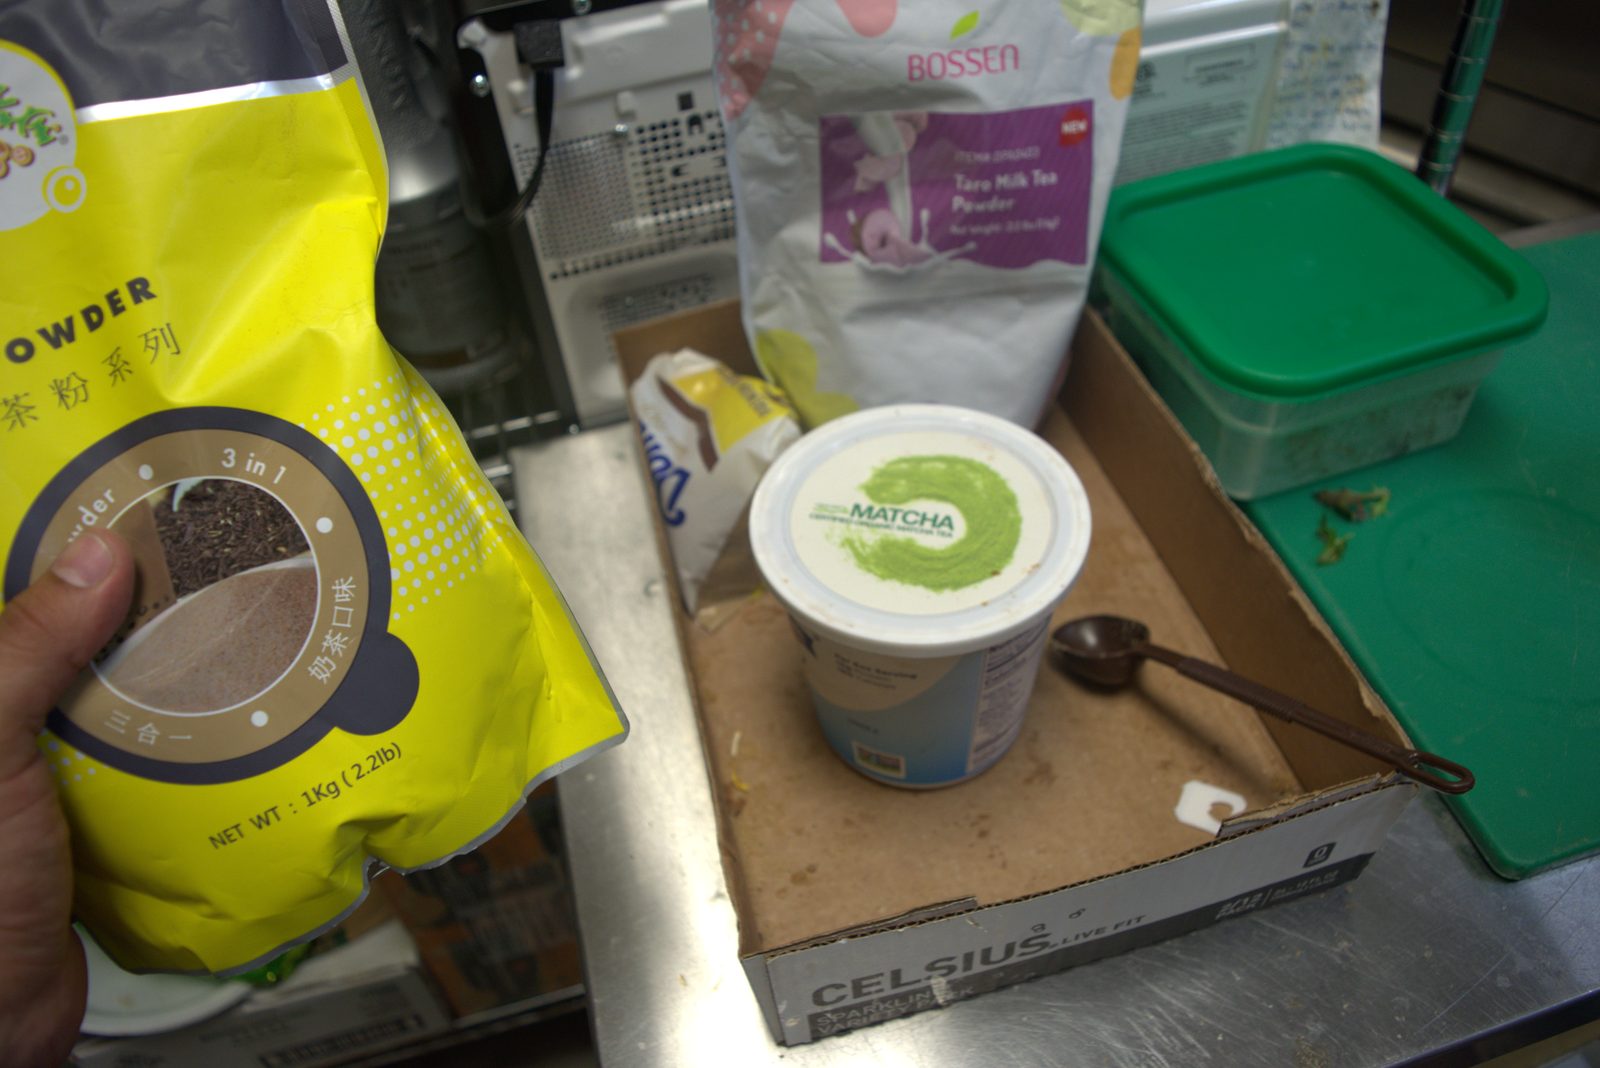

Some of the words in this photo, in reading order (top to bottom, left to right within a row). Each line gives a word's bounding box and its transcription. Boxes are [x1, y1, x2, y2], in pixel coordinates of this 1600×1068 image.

[907, 44, 1020, 82] BOSSEN
[1062, 119, 1087, 134] NEW
[955, 173, 992, 192] Taro
[995, 171, 1028, 190] Milk
[1031, 168, 1058, 187] Tea
[952, 195, 1014, 213] Powder
[5, 277, 157, 364] OWDER
[0, 322, 181, 432] 茶粉系列
[221, 447, 237, 469] 3
[245, 453, 266, 476] in
[273, 465, 286, 484] 1
[851, 503, 955, 531] MATCHA
[308, 576, 356, 685] 奶茶口味
[103, 709, 192, 747] 三合一
[208, 823, 245, 849] NET
[249, 806, 281, 830] WT
[301, 781, 341, 807] 1Kg
[811, 933, 1053, 1007] CELSIUS
[1062, 926, 1107, 945] LIVE
[1113, 915, 1146, 931] FIT
[817, 984, 944, 1026] SPARKLIN
